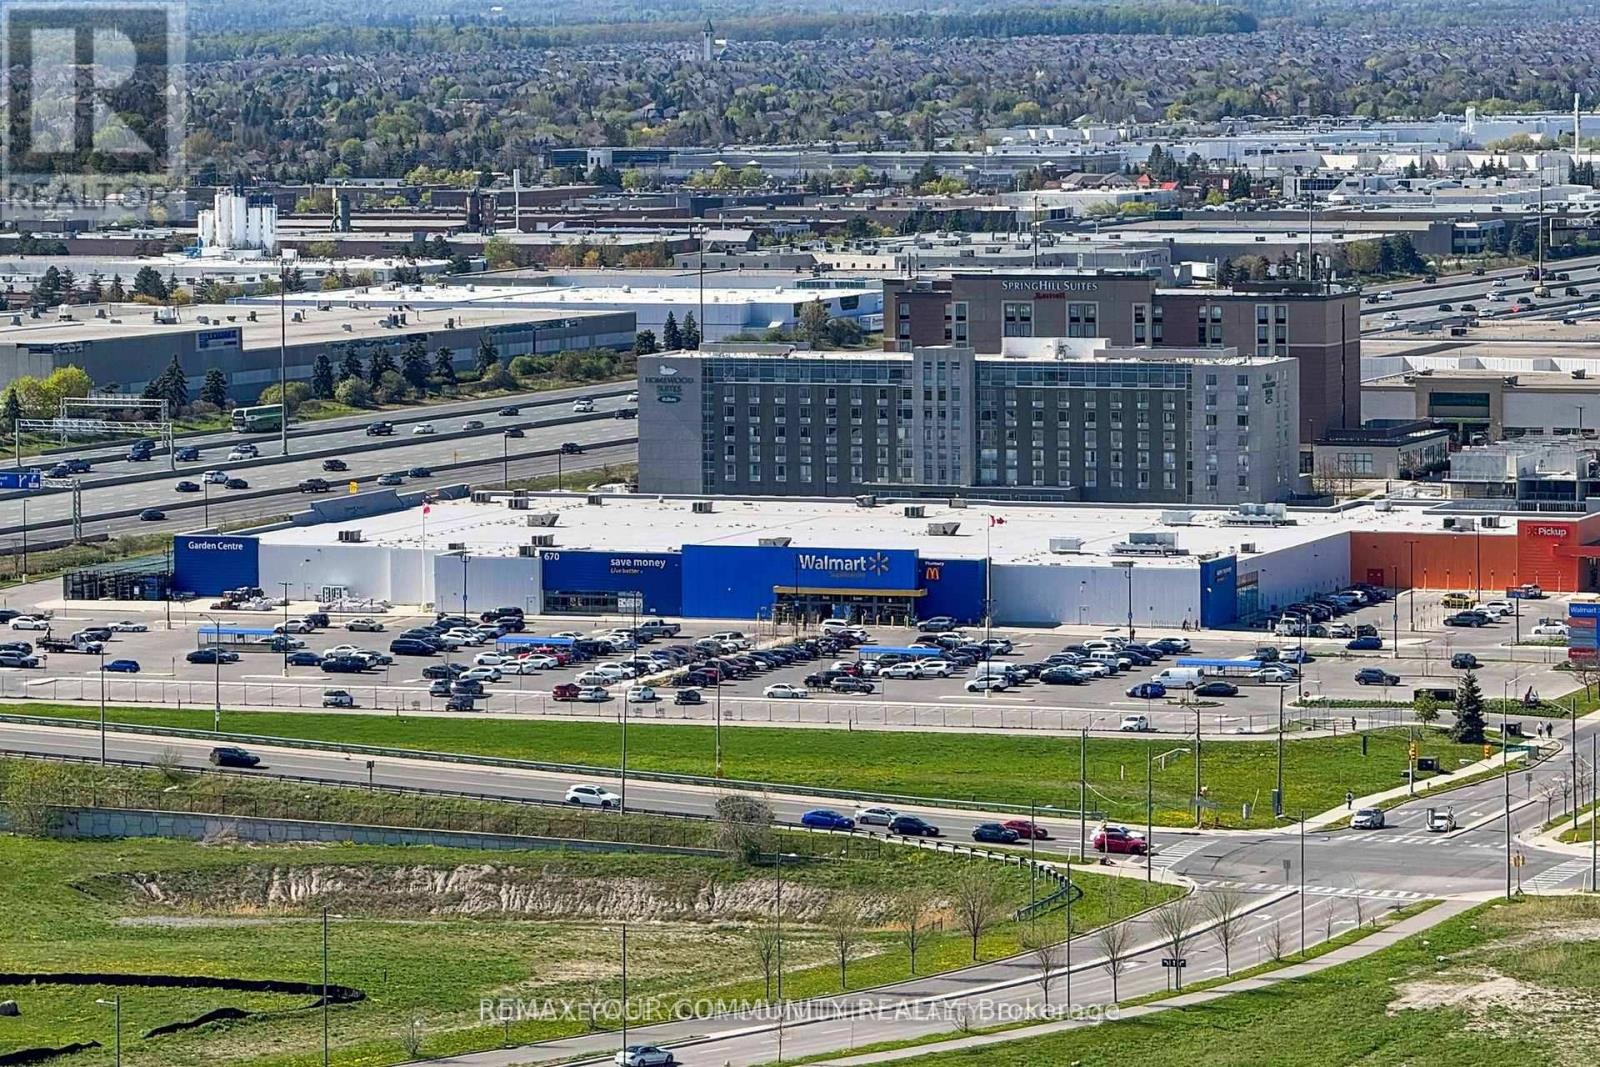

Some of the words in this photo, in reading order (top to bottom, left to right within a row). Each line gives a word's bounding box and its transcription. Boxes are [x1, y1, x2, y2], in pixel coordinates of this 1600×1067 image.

[1063, 280, 1099, 291] SUITES
[1538, 527, 1567, 537] Pickup
[188, 541, 217, 550] Garden
[217, 542, 244, 551] Centre
[544, 552, 560, 561] 670
[610, 558, 632, 567] save
[633, 559, 666, 570] money
[800, 554, 867, 571] Walmart
